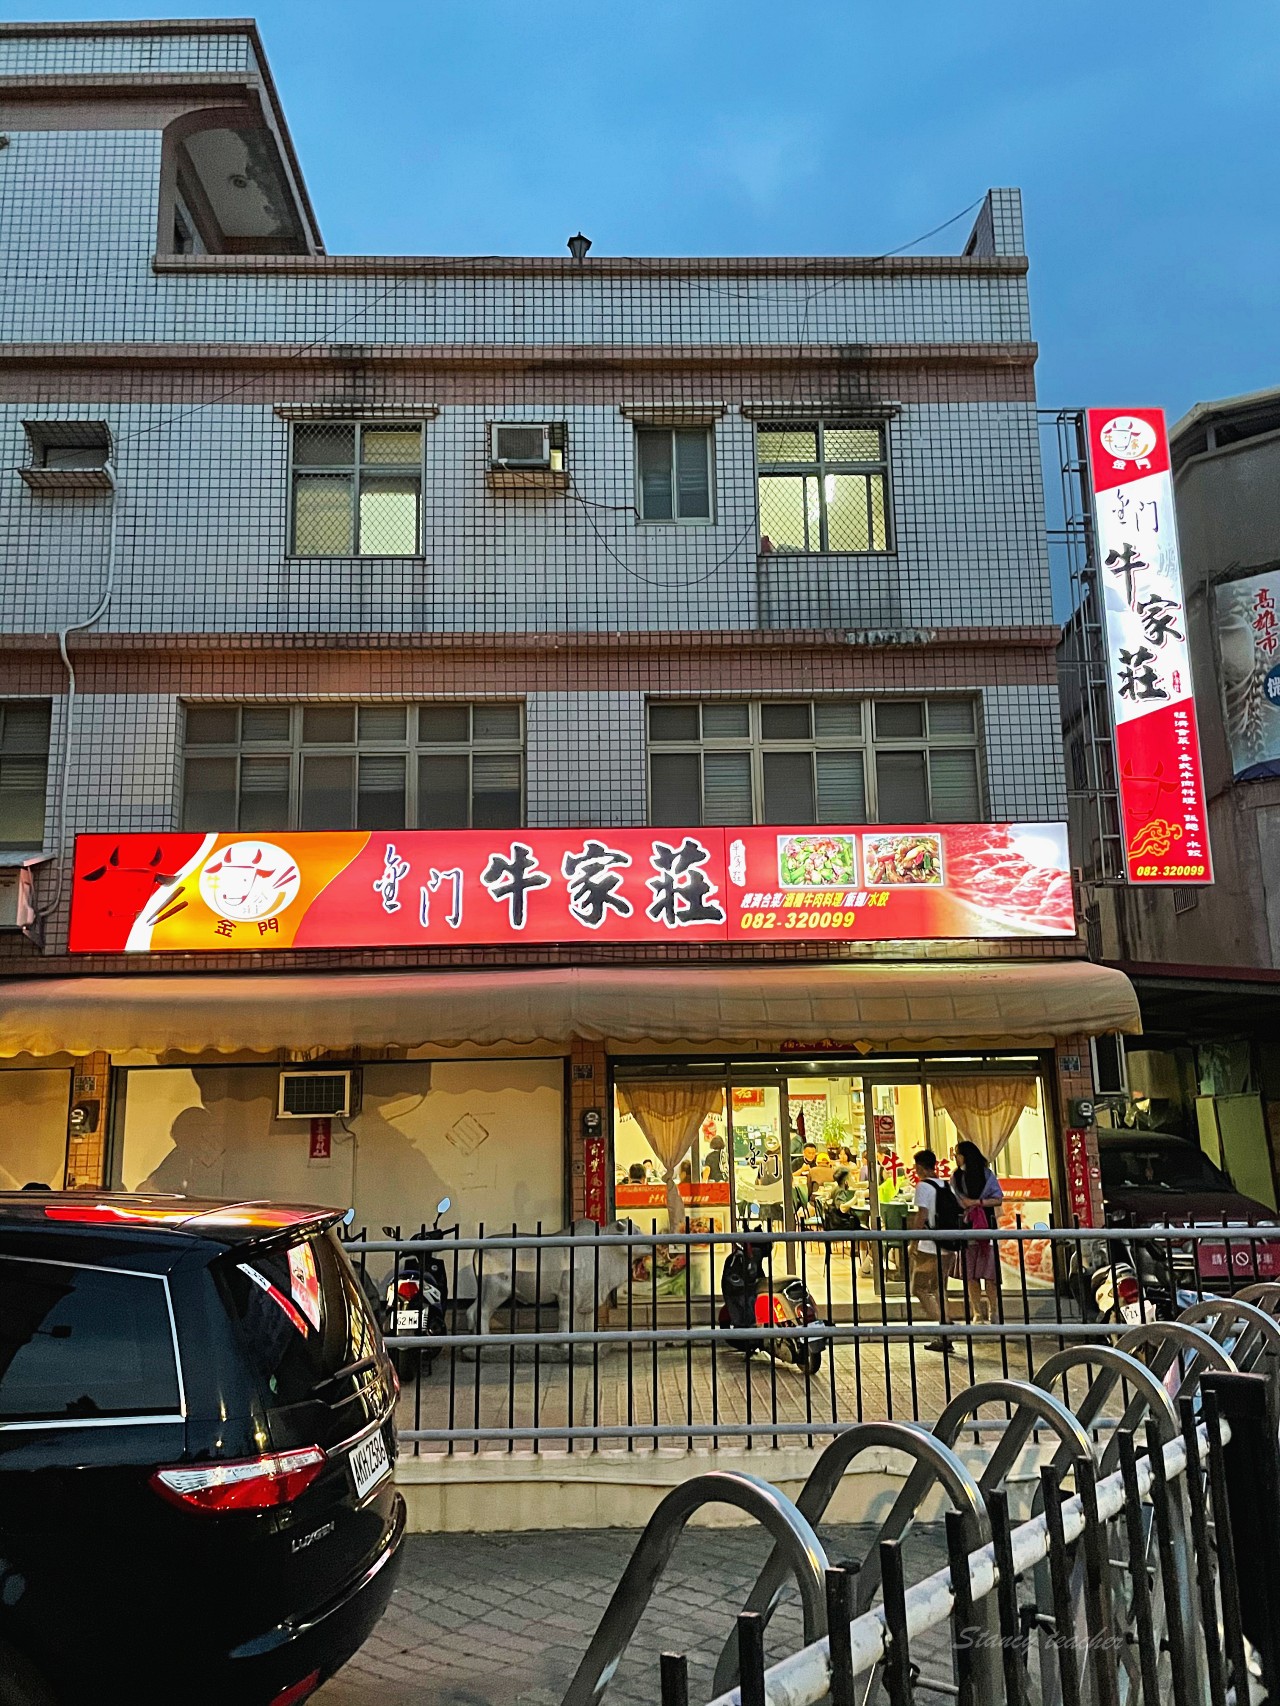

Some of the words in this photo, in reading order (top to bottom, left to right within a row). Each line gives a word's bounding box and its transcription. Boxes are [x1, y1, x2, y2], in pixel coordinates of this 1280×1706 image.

[1252, 587, 1279, 655] 高雄市
[1135, 865, 1205, 877] 082-320099
[214, 917, 279, 938] 金門
[740, 911, 856, 929] 082-320099
